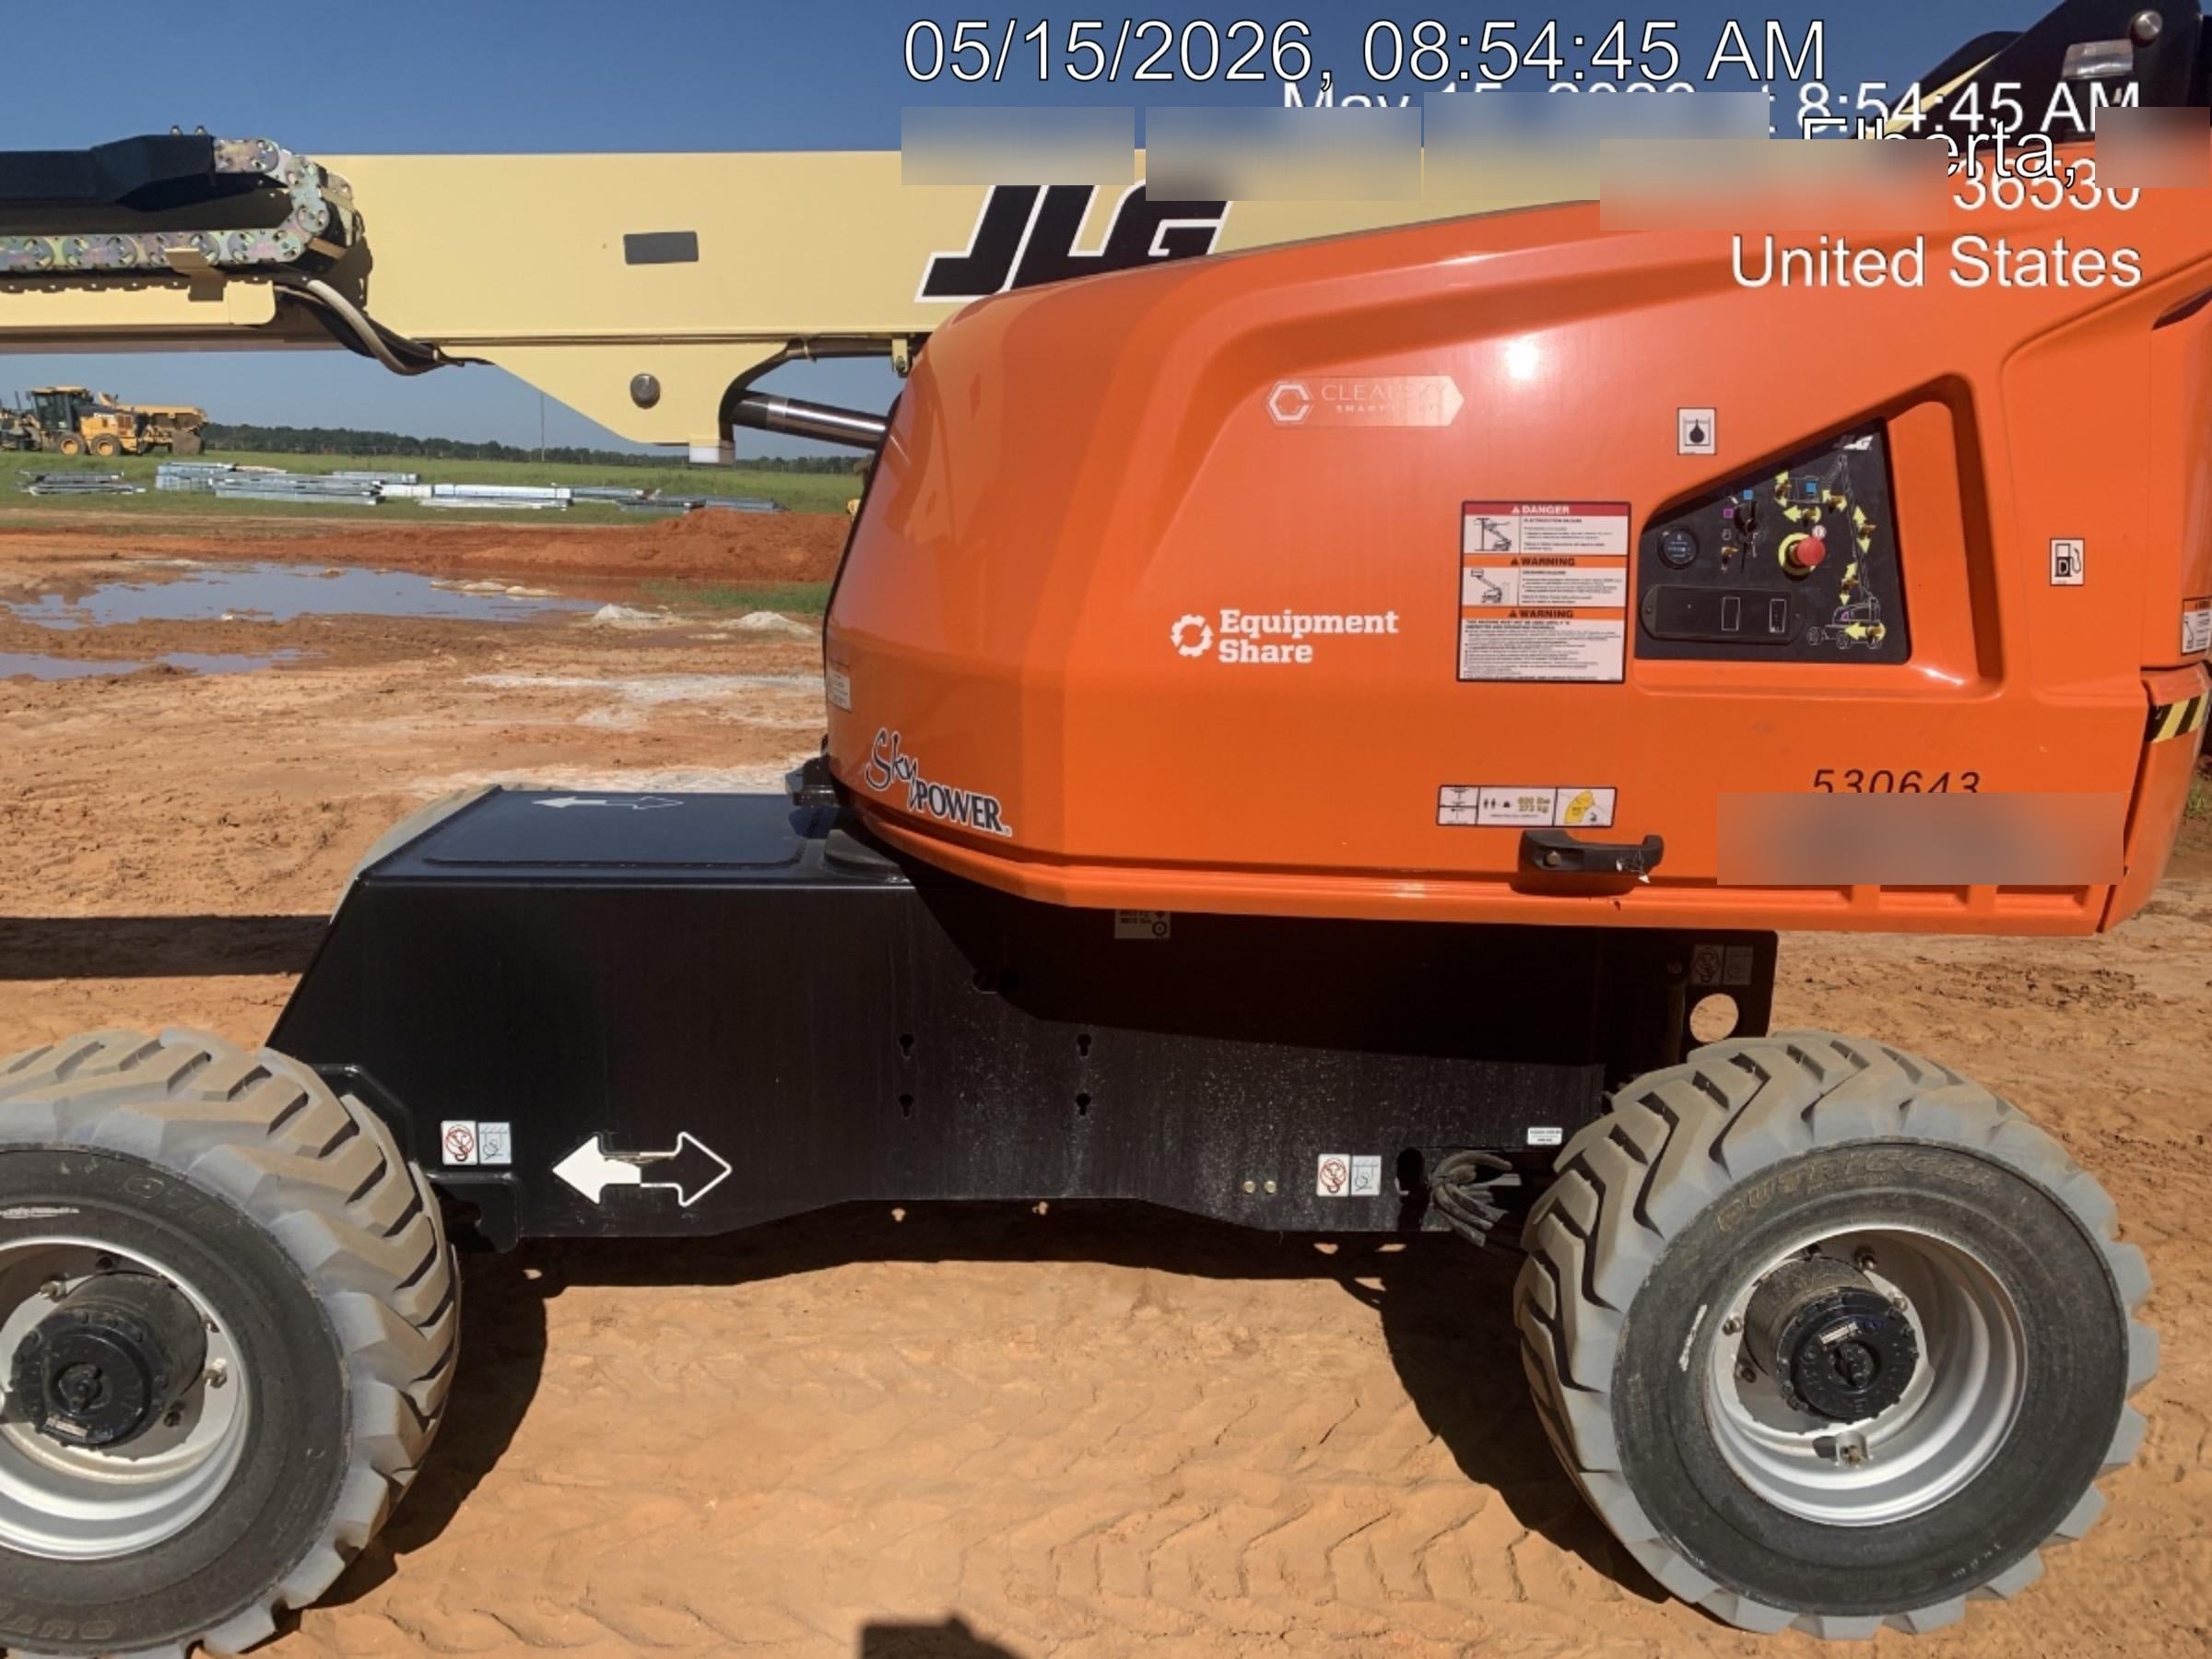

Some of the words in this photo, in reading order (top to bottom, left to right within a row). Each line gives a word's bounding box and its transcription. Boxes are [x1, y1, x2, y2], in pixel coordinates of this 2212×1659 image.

[1522, 505, 1571, 515] DANGER
[1521, 557, 1575, 567] WARNING
[1520, 609, 1574, 618] WARNING
[1219, 608, 1399, 639] Equipment
[1218, 639, 1313, 664] Share
[1812, 769, 1981, 794] 530643
